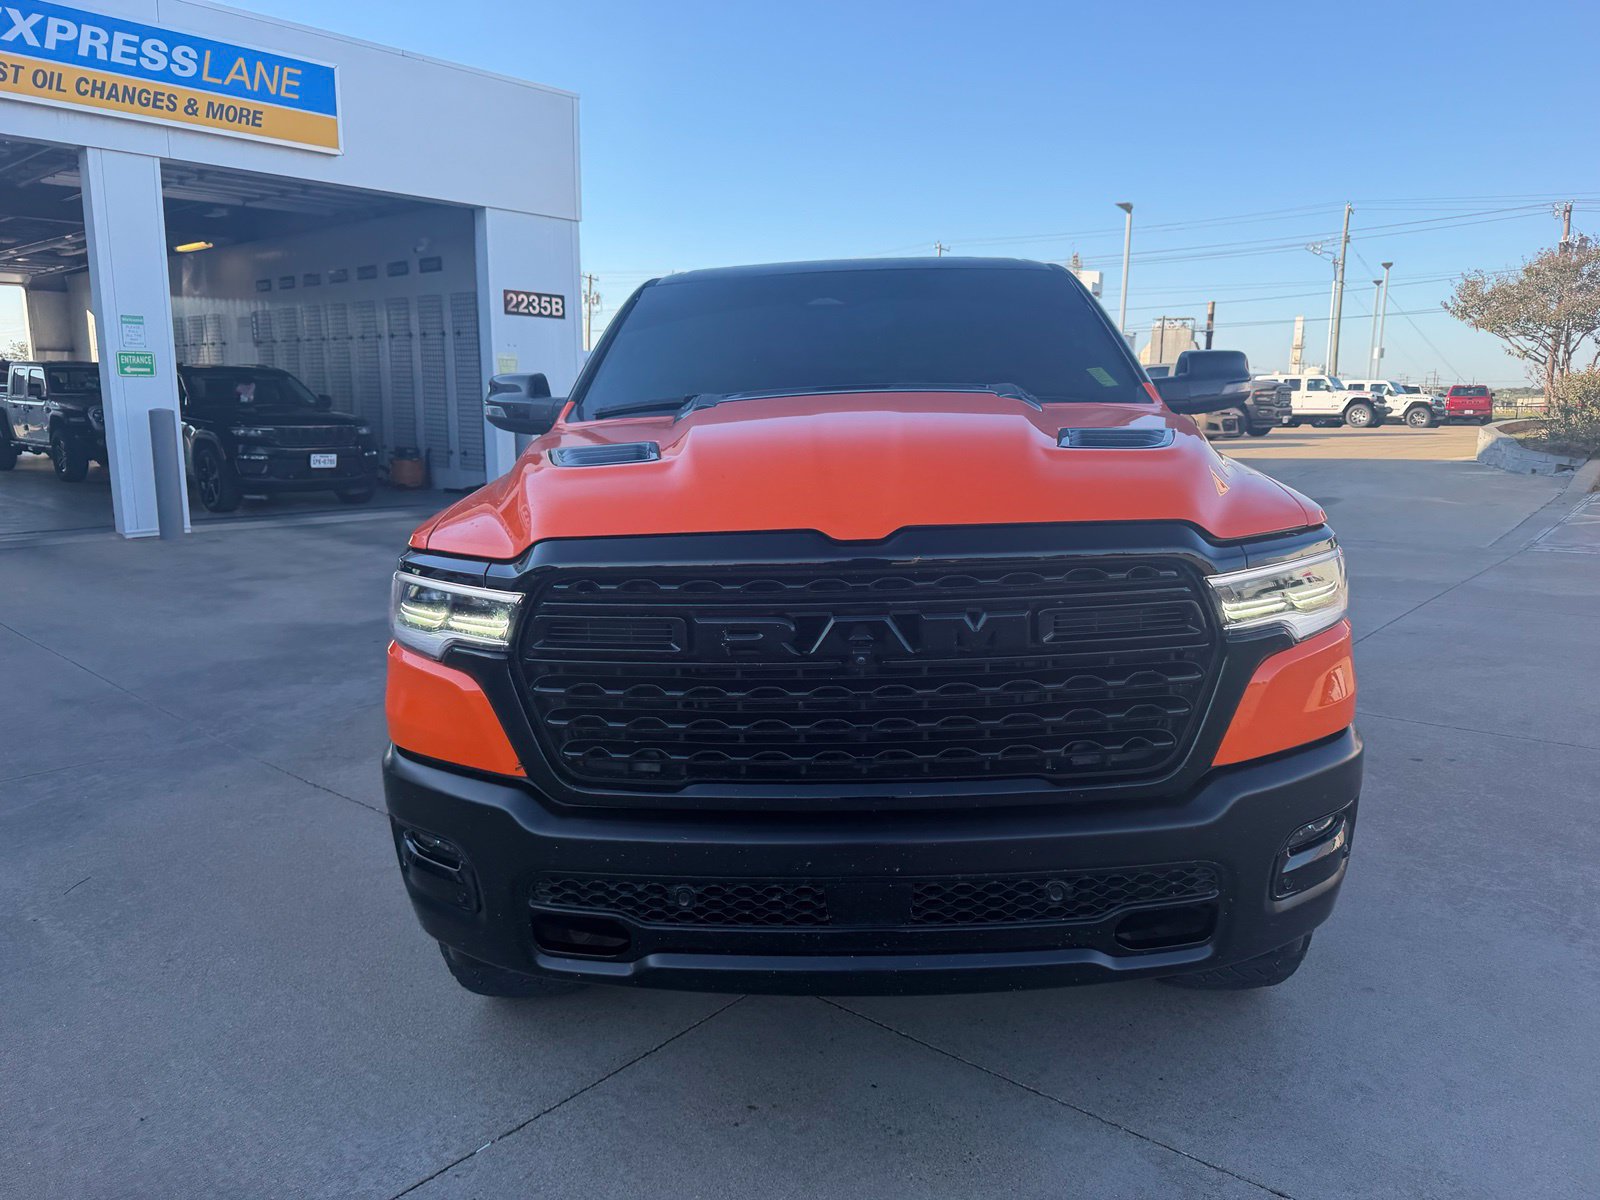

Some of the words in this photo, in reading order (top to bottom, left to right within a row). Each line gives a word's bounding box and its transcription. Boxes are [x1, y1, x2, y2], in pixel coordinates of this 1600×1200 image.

[32, 69, 67, 93] OIL
[75, 76, 178, 112] CHANGES
[183, 98, 199, 117] &
[206, 101, 264, 127] MORE
[506, 293, 563, 316] 2235B
[120, 355, 152, 365] ENTRANCE
[694, 610, 1029, 657] RAM
